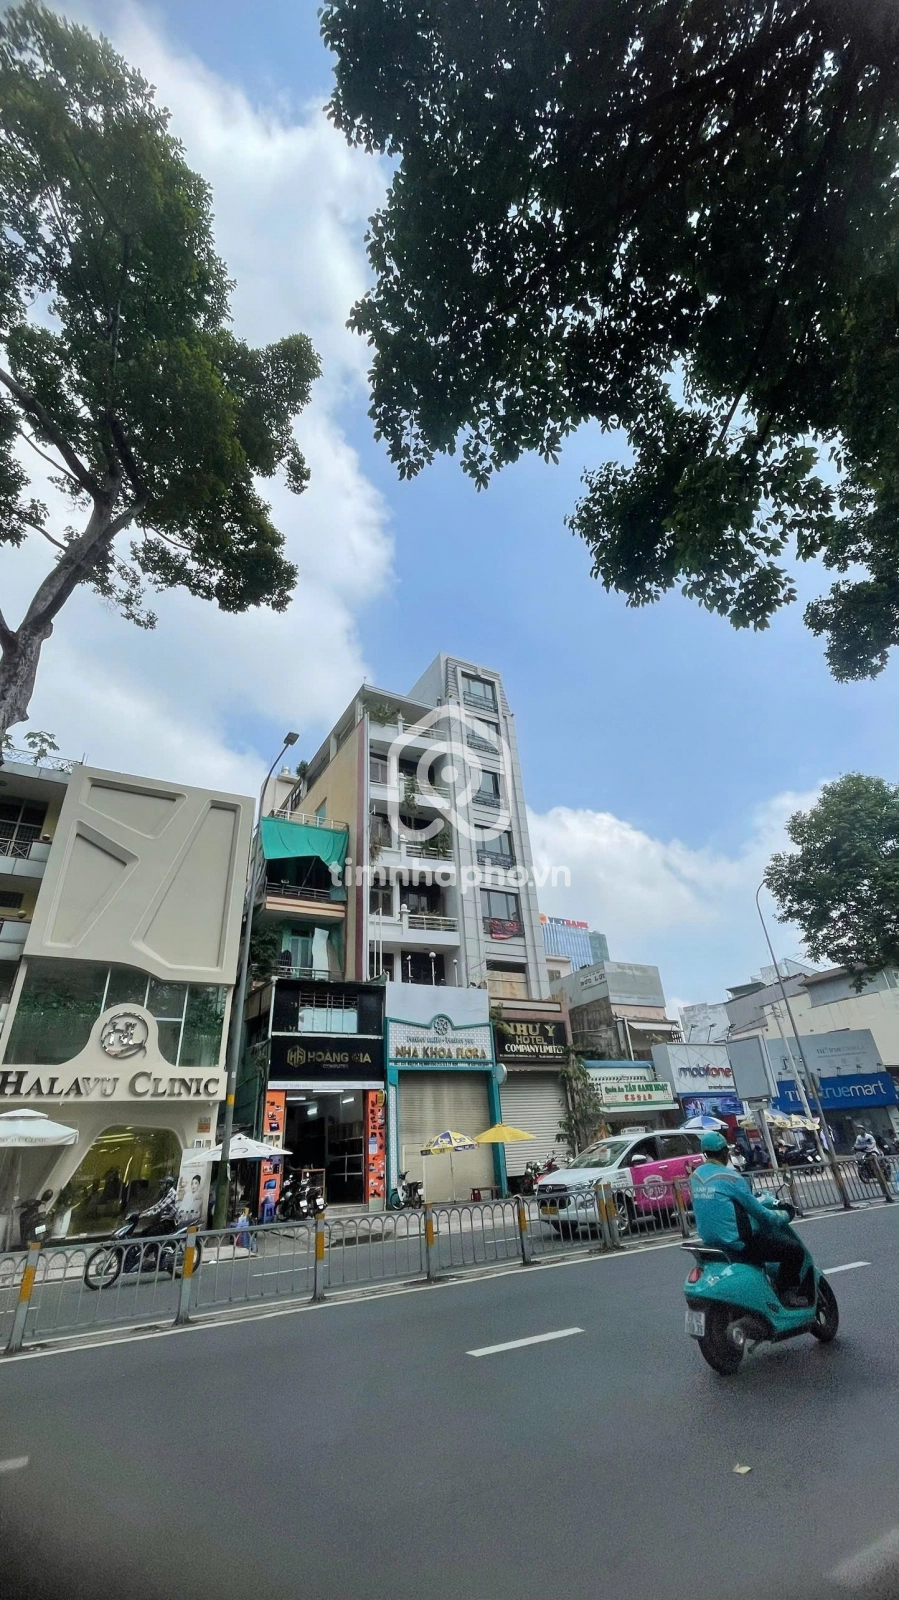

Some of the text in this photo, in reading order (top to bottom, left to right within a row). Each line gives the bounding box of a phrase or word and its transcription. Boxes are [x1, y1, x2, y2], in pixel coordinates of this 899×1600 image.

[516, 1036, 548, 1045] HOTEL
[395, 1046, 419, 1058] NHA
[422, 1047, 453, 1059] KHOA
[456, 1048, 487, 1060] FLORA
[505, 1043, 540, 1053] COMPANY
[307, 1049, 349, 1062] HOÀNG
[678, 1063, 732, 1078] mobifone
[128, 1071, 219, 1097] CLINIC
[820, 1080, 887, 1099] truemart
